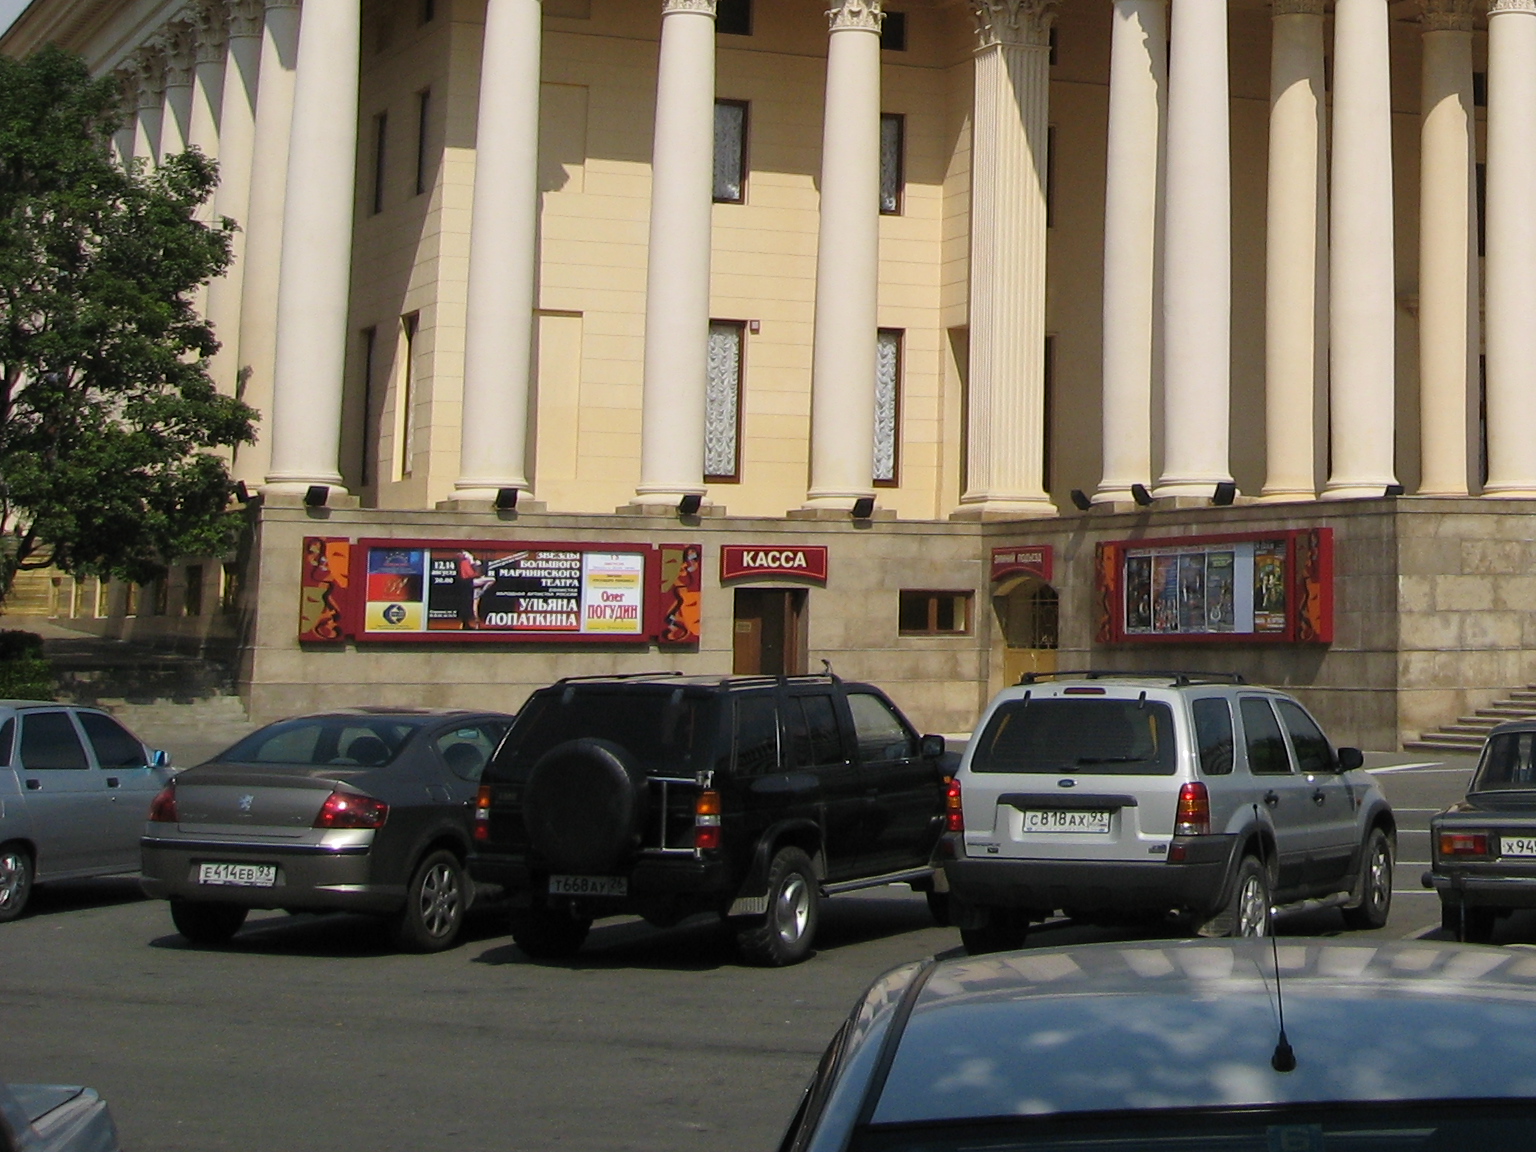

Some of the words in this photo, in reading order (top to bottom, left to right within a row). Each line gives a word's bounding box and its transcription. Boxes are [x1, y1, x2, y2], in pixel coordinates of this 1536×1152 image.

[520, 560, 580, 568] БОЛЬШОГО
[743, 551, 807, 567] КАССА
[500, 569, 580, 578] МАРИИНСКОГО
[541, 578, 579, 587] ТЕАТРА
[601, 591, 625, 602] Олег
[519, 598, 578, 611] УЛЬЯНА
[485, 612, 578, 626] ЛОПАТКИНА
[587, 604, 639, 622] ПОГУДИН
[1030, 811, 1086, 826] С818АХ
[204, 864, 254, 880] Е414ЕВ
